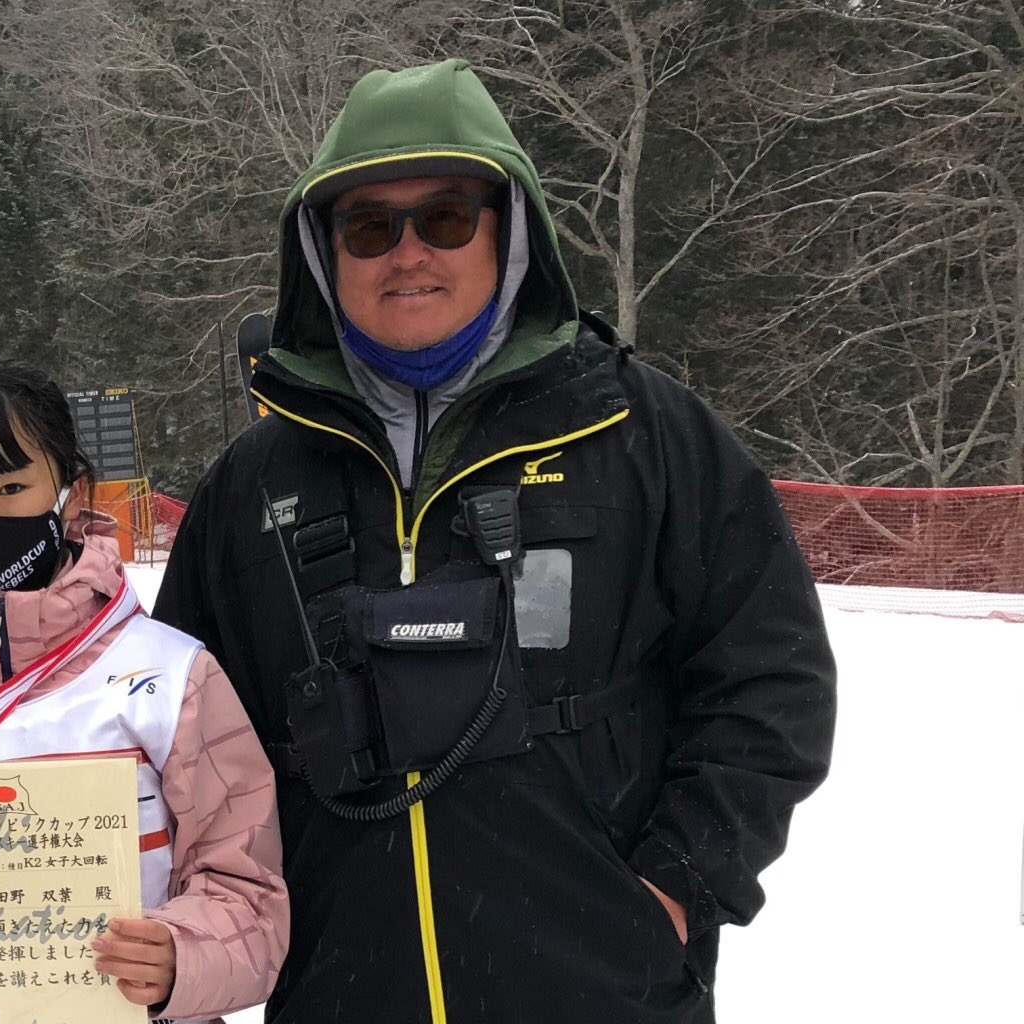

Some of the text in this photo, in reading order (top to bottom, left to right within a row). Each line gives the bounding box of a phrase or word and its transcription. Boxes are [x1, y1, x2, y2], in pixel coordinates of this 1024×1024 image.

[391, 622, 464, 636] CONTERRA
[94, 815, 128, 829] 2021
[23, 857, 42, 868] K2
[45, 854, 108, 868] 女子大回転
[42, 886, 72, 903] 双葉
[95, 886, 112, 900] 殿
